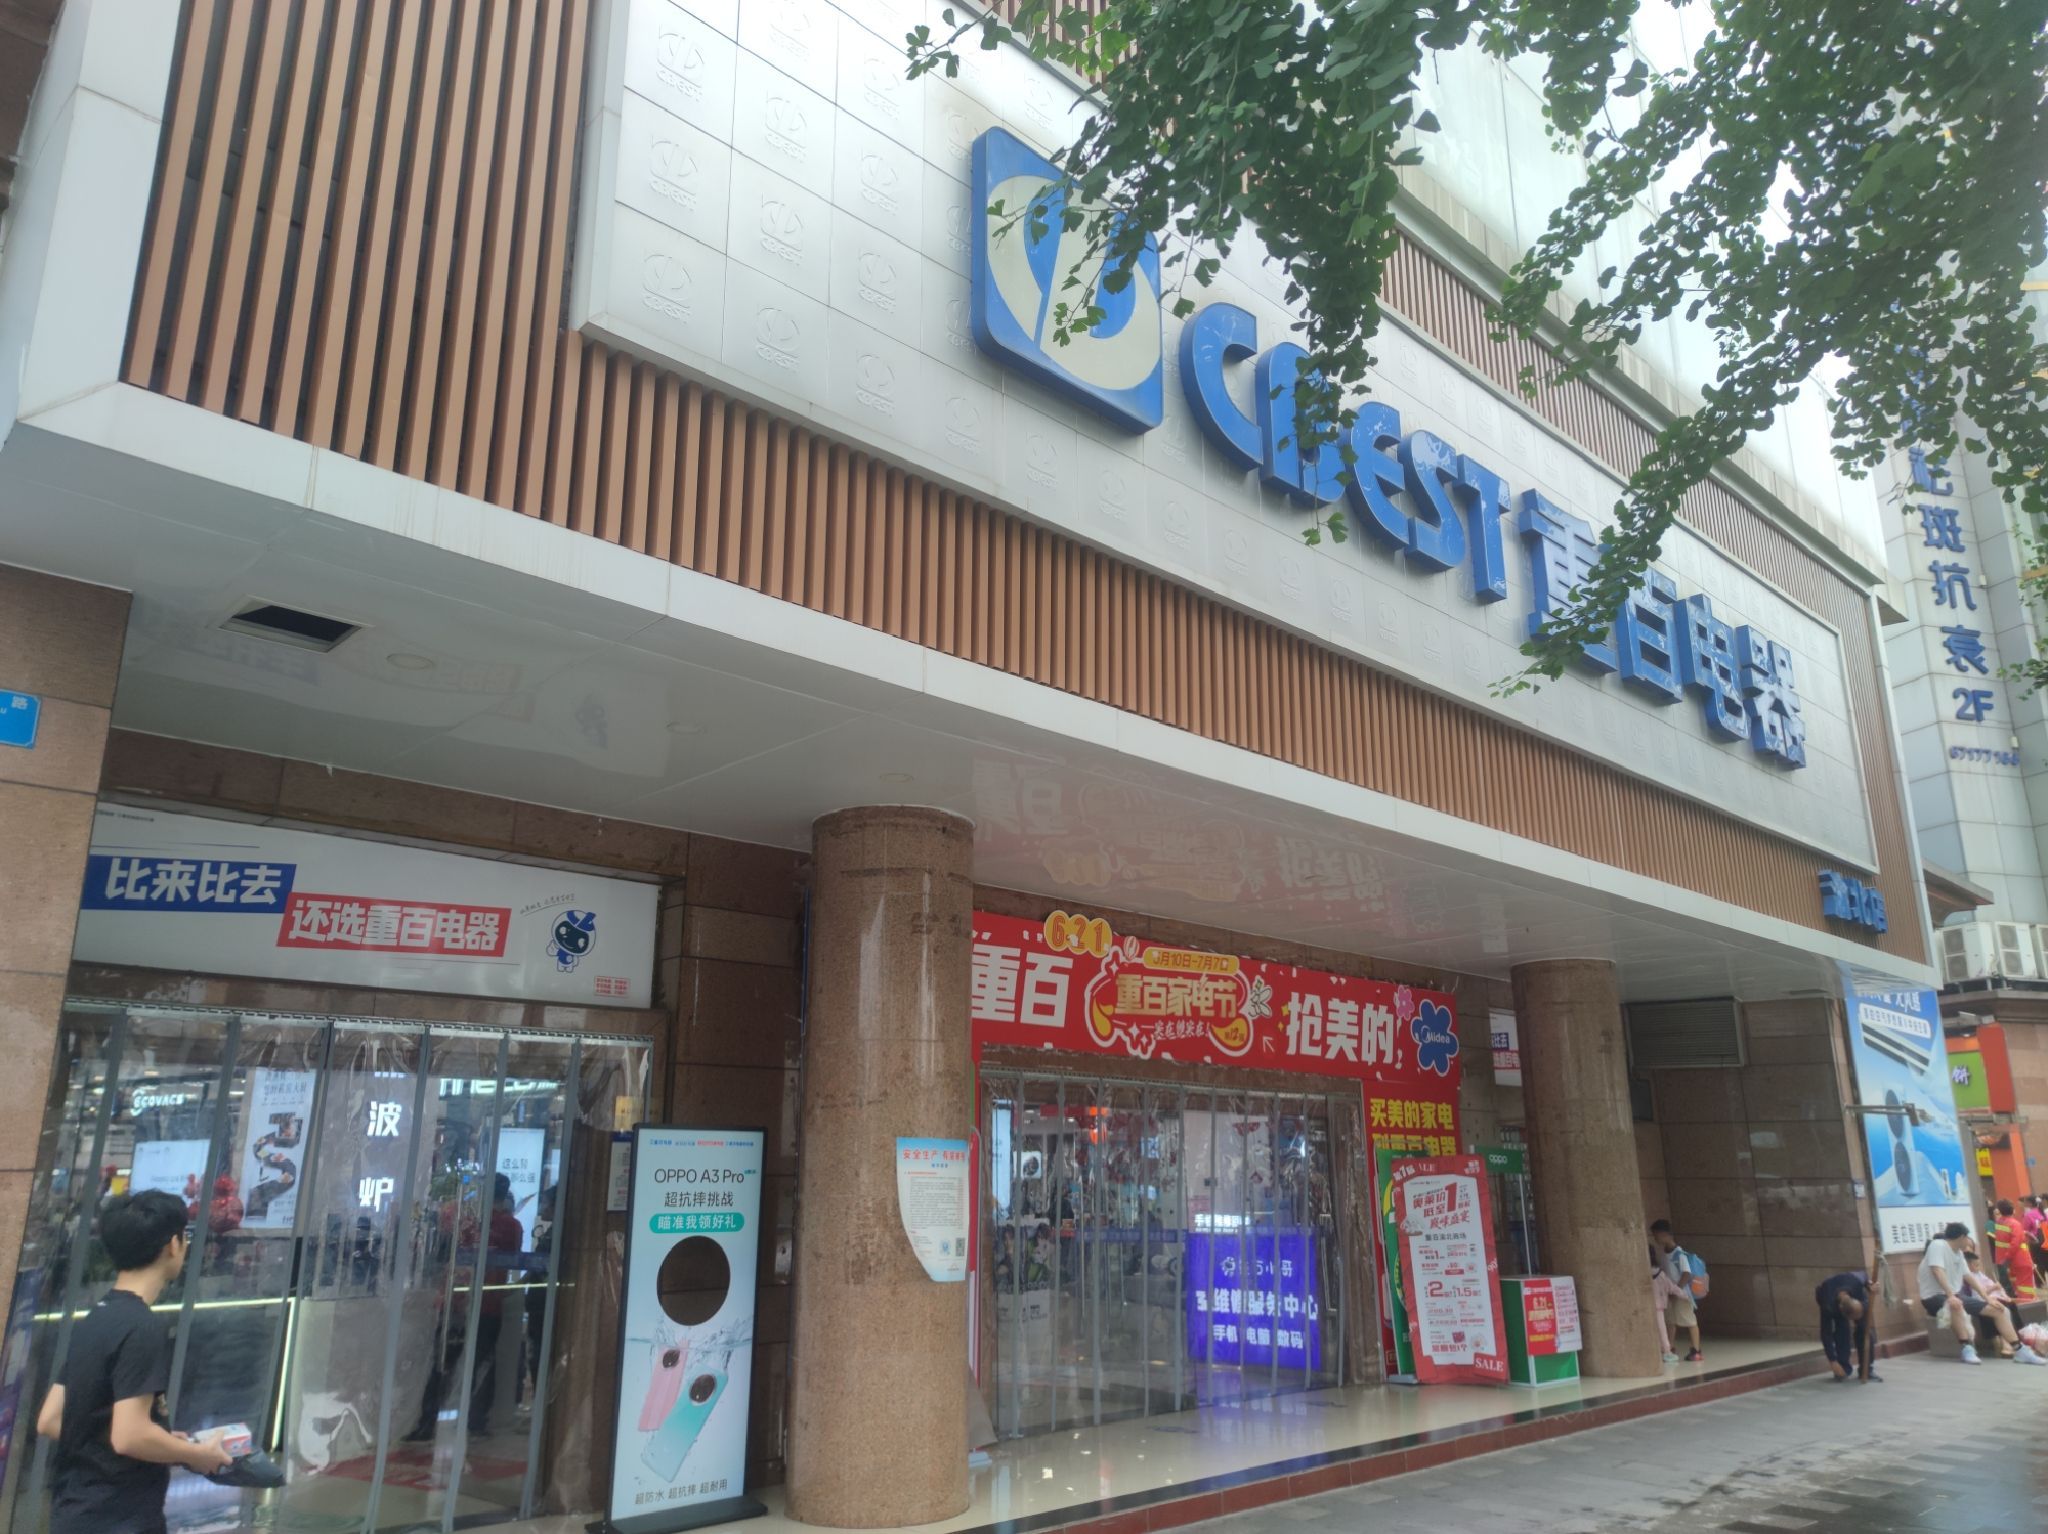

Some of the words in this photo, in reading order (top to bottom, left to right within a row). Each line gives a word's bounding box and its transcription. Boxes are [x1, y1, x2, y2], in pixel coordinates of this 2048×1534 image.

[1180, 303, 1511, 603] CBEST
[1519, 488, 1807, 770] 重百电器
[1952, 687, 1994, 722] 2F
[105, 858, 283, 906] 比来比去
[288, 900, 501, 951] 还选重百电器
[972, 943, 1074, 1028] 重百
[1115, 974, 1238, 1018] 重百家电节
[1286, 991, 1394, 1068] 抢美的
[1425, 1031, 1451, 1045] Midea
[1370, 1098, 1455, 1131] 买美的家电
[654, 1168, 697, 1184] OPPO
[700, 1169, 720, 1183] A3
[723, 1169, 745, 1184] Pro
[664, 1191, 734, 1207] 超抗摔挑战
[657, 1214, 736, 1230] 瞄准我领好礼
[1212, 1324, 1238, 1343] 手机
[1246, 1326, 1270, 1346] 电脑
[1475, 1357, 1504, 1373] SALE
